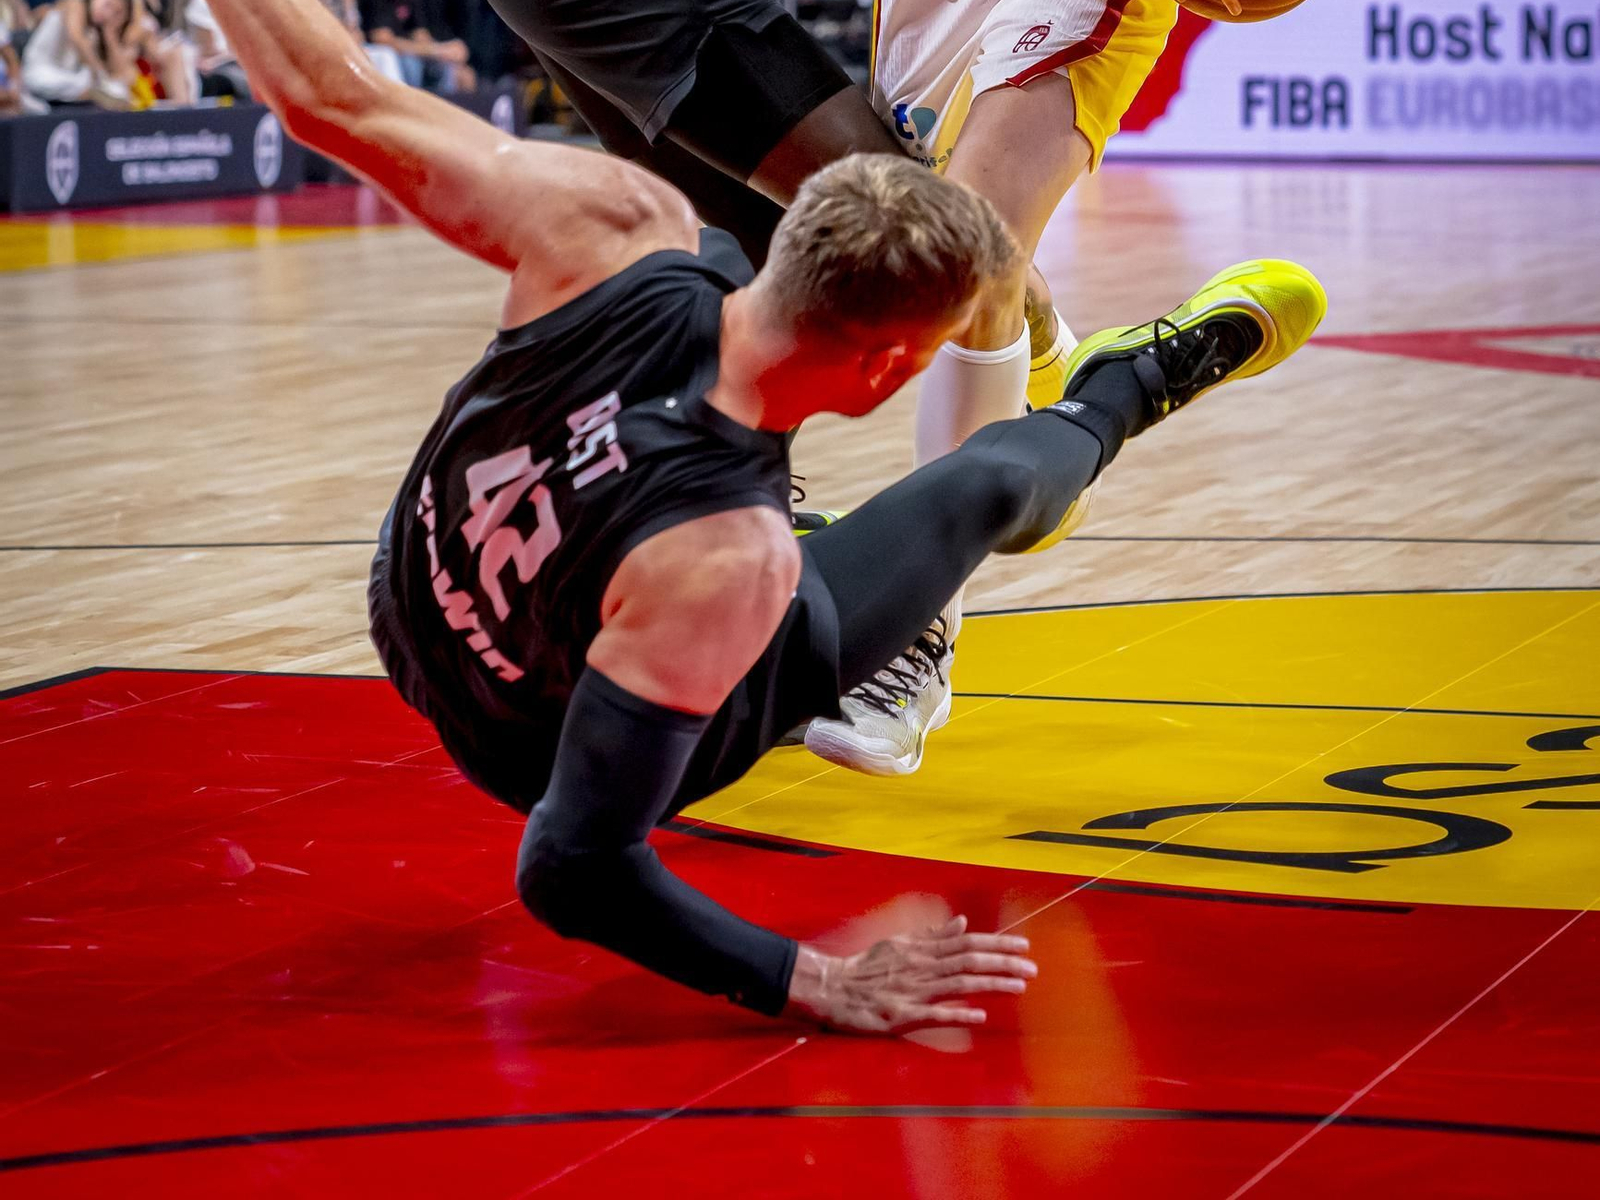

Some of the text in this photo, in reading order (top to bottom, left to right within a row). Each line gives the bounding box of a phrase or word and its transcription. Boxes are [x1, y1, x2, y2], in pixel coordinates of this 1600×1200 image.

[1365, 2, 1600, 64] Host Na
[1240, 75, 1352, 131] FIBA
[460, 444, 562, 623] 42
